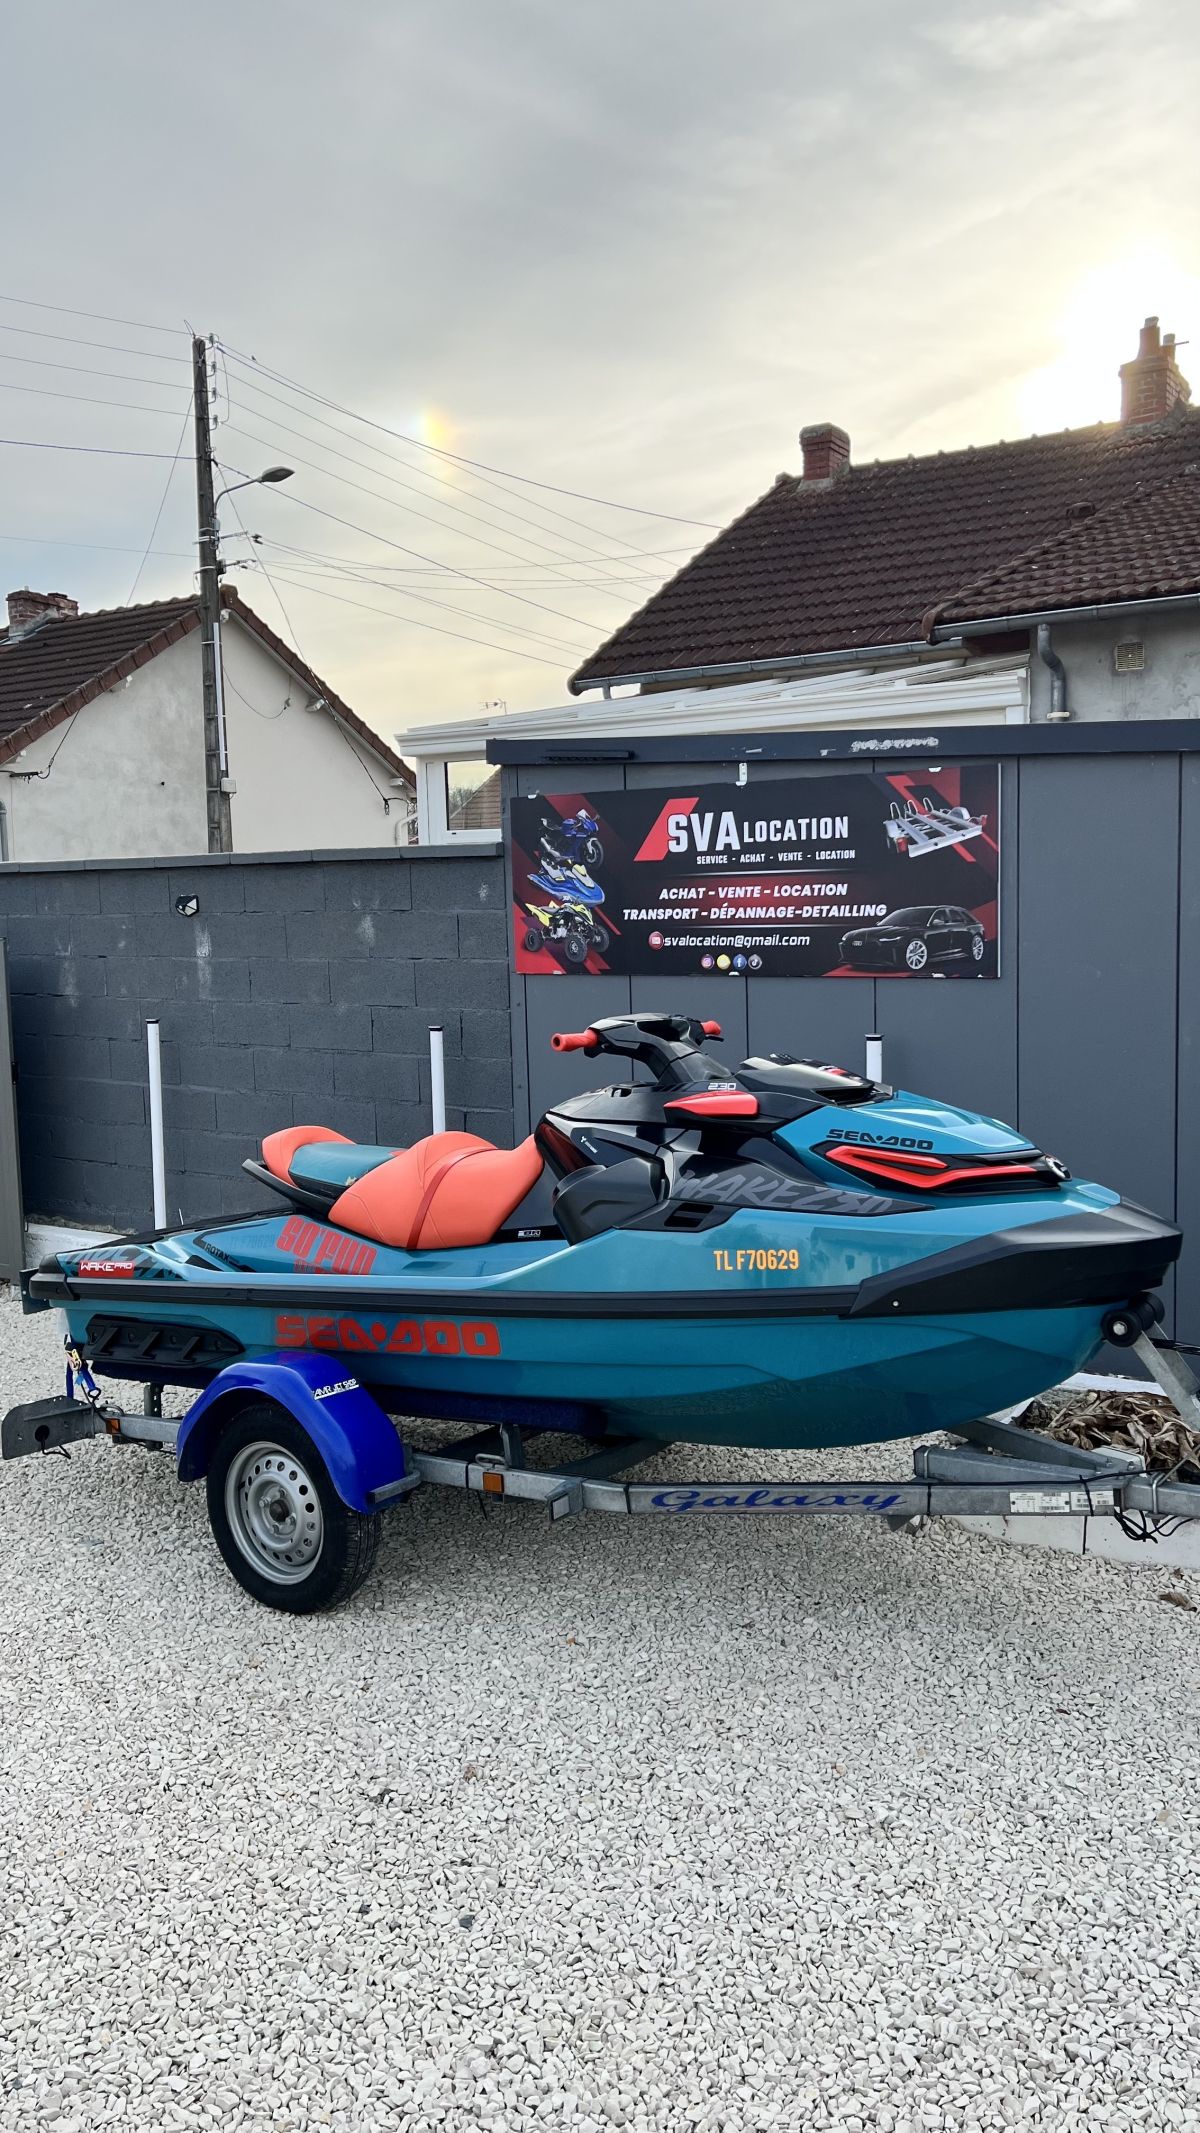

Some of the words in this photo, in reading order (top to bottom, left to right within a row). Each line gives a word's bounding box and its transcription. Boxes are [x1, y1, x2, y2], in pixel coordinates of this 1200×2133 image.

[667, 810, 741, 853] SVA
[743, 816, 849, 844] LOCATION
[696, 855, 728, 865] SERVICE
[740, 853, 766, 864] ACHAT
[778, 852, 803, 862] VENTE
[815, 849, 856, 860] LOCATION
[659, 887, 706, 900] ACHAT
[718, 885, 761, 899] VENTE
[773, 883, 848, 897] LOCATION
[623, 908, 699, 920] TRANSPORT
[664, 934, 811, 948] svalocation@gmail.com
[707, 1082, 737, 1091] 230
[650, 1489, 907, 1512] Galaxy
